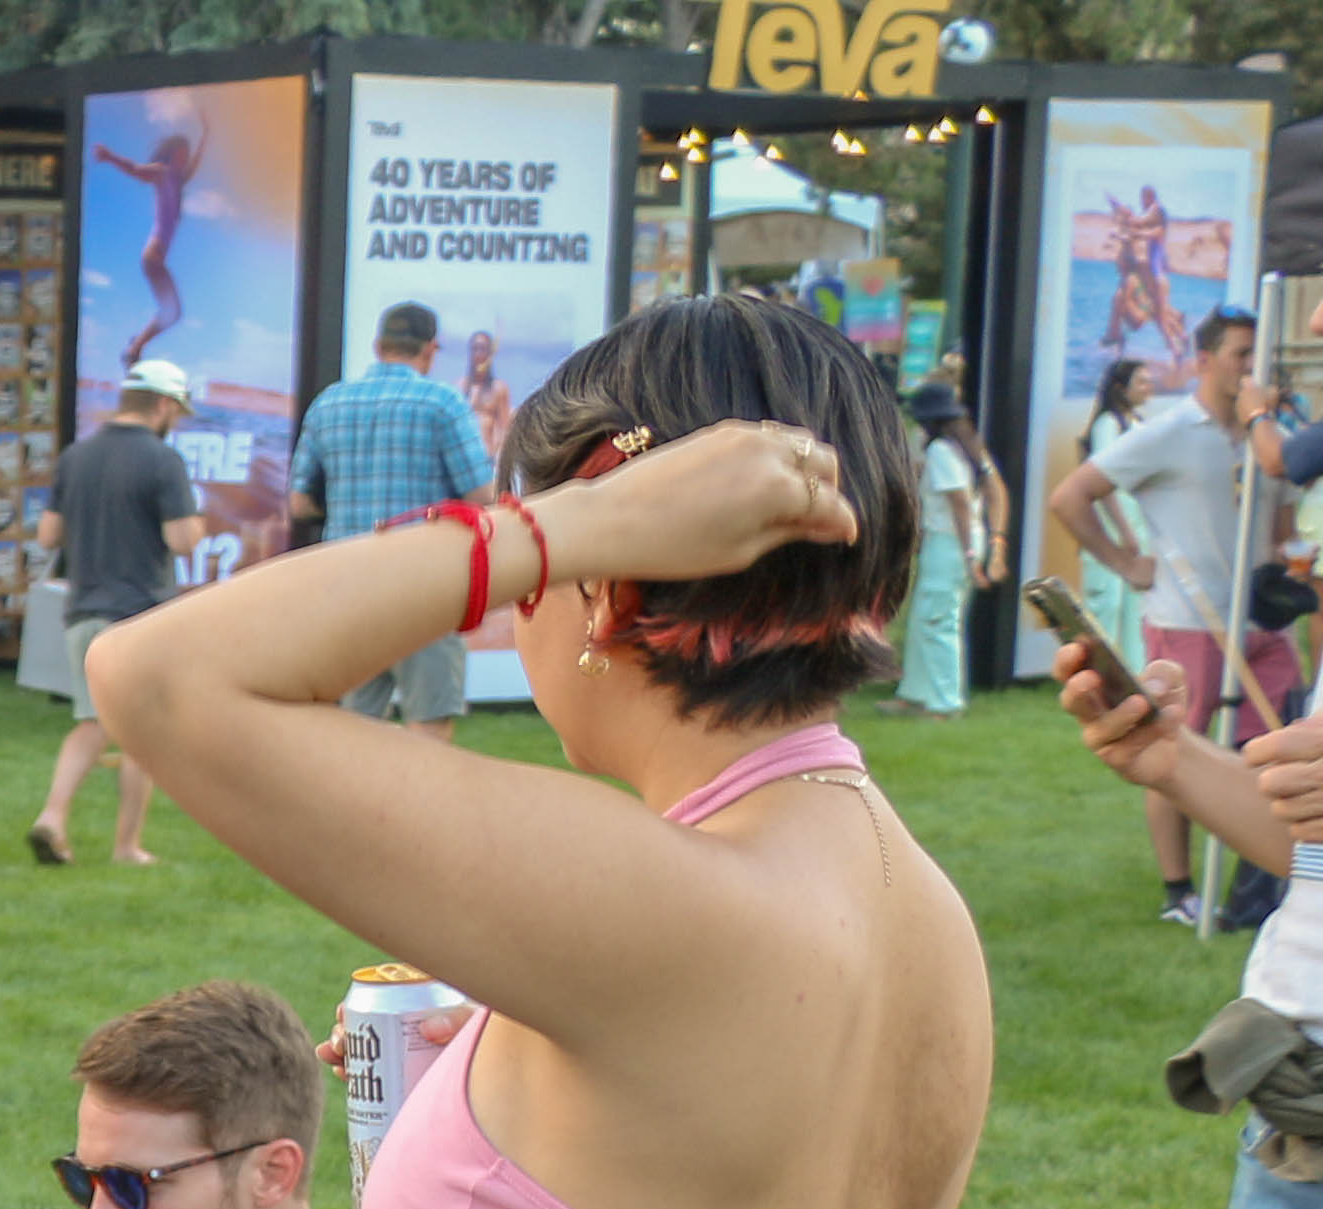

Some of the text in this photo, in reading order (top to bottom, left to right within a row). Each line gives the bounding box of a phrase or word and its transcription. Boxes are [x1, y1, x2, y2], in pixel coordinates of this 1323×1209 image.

[370, 157, 557, 193] 40 YEARS OF
[368, 195, 540, 226] ADVENTURE
[367, 230, 589, 263] AND COUNTING
